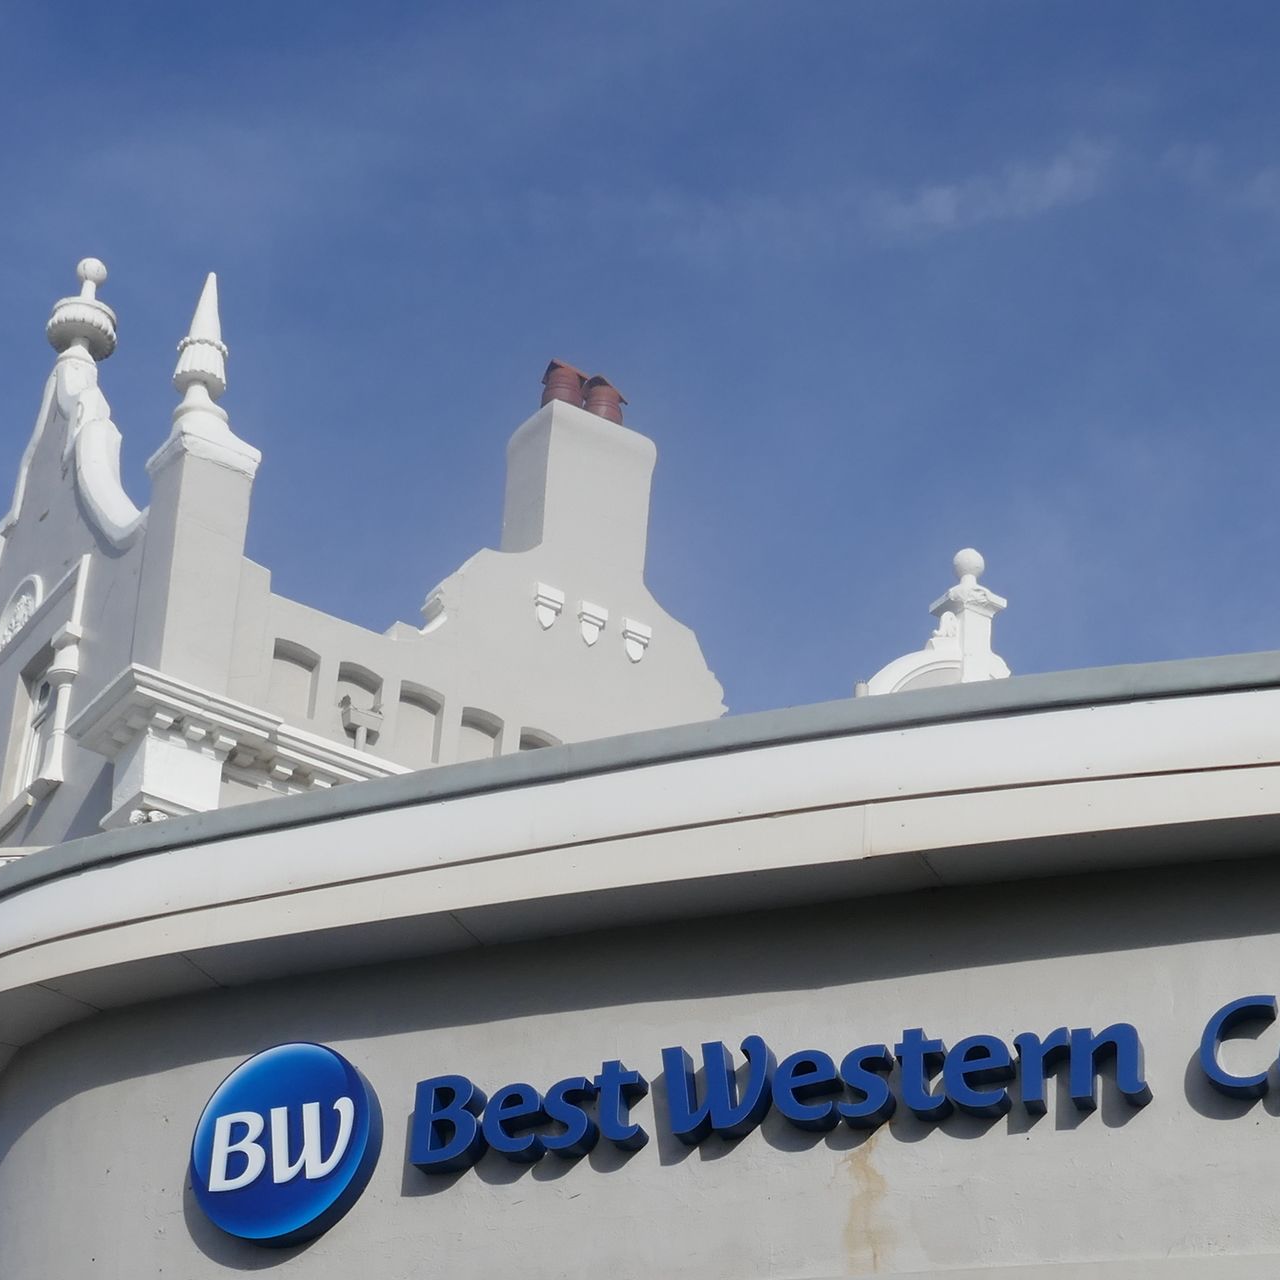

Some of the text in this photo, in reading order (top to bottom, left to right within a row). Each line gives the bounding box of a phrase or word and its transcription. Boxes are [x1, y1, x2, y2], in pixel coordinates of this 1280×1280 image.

[208, 1096, 355, 1193] BW
[408, 1060, 648, 1173] Best
[660, 1022, 1152, 1143] Western
